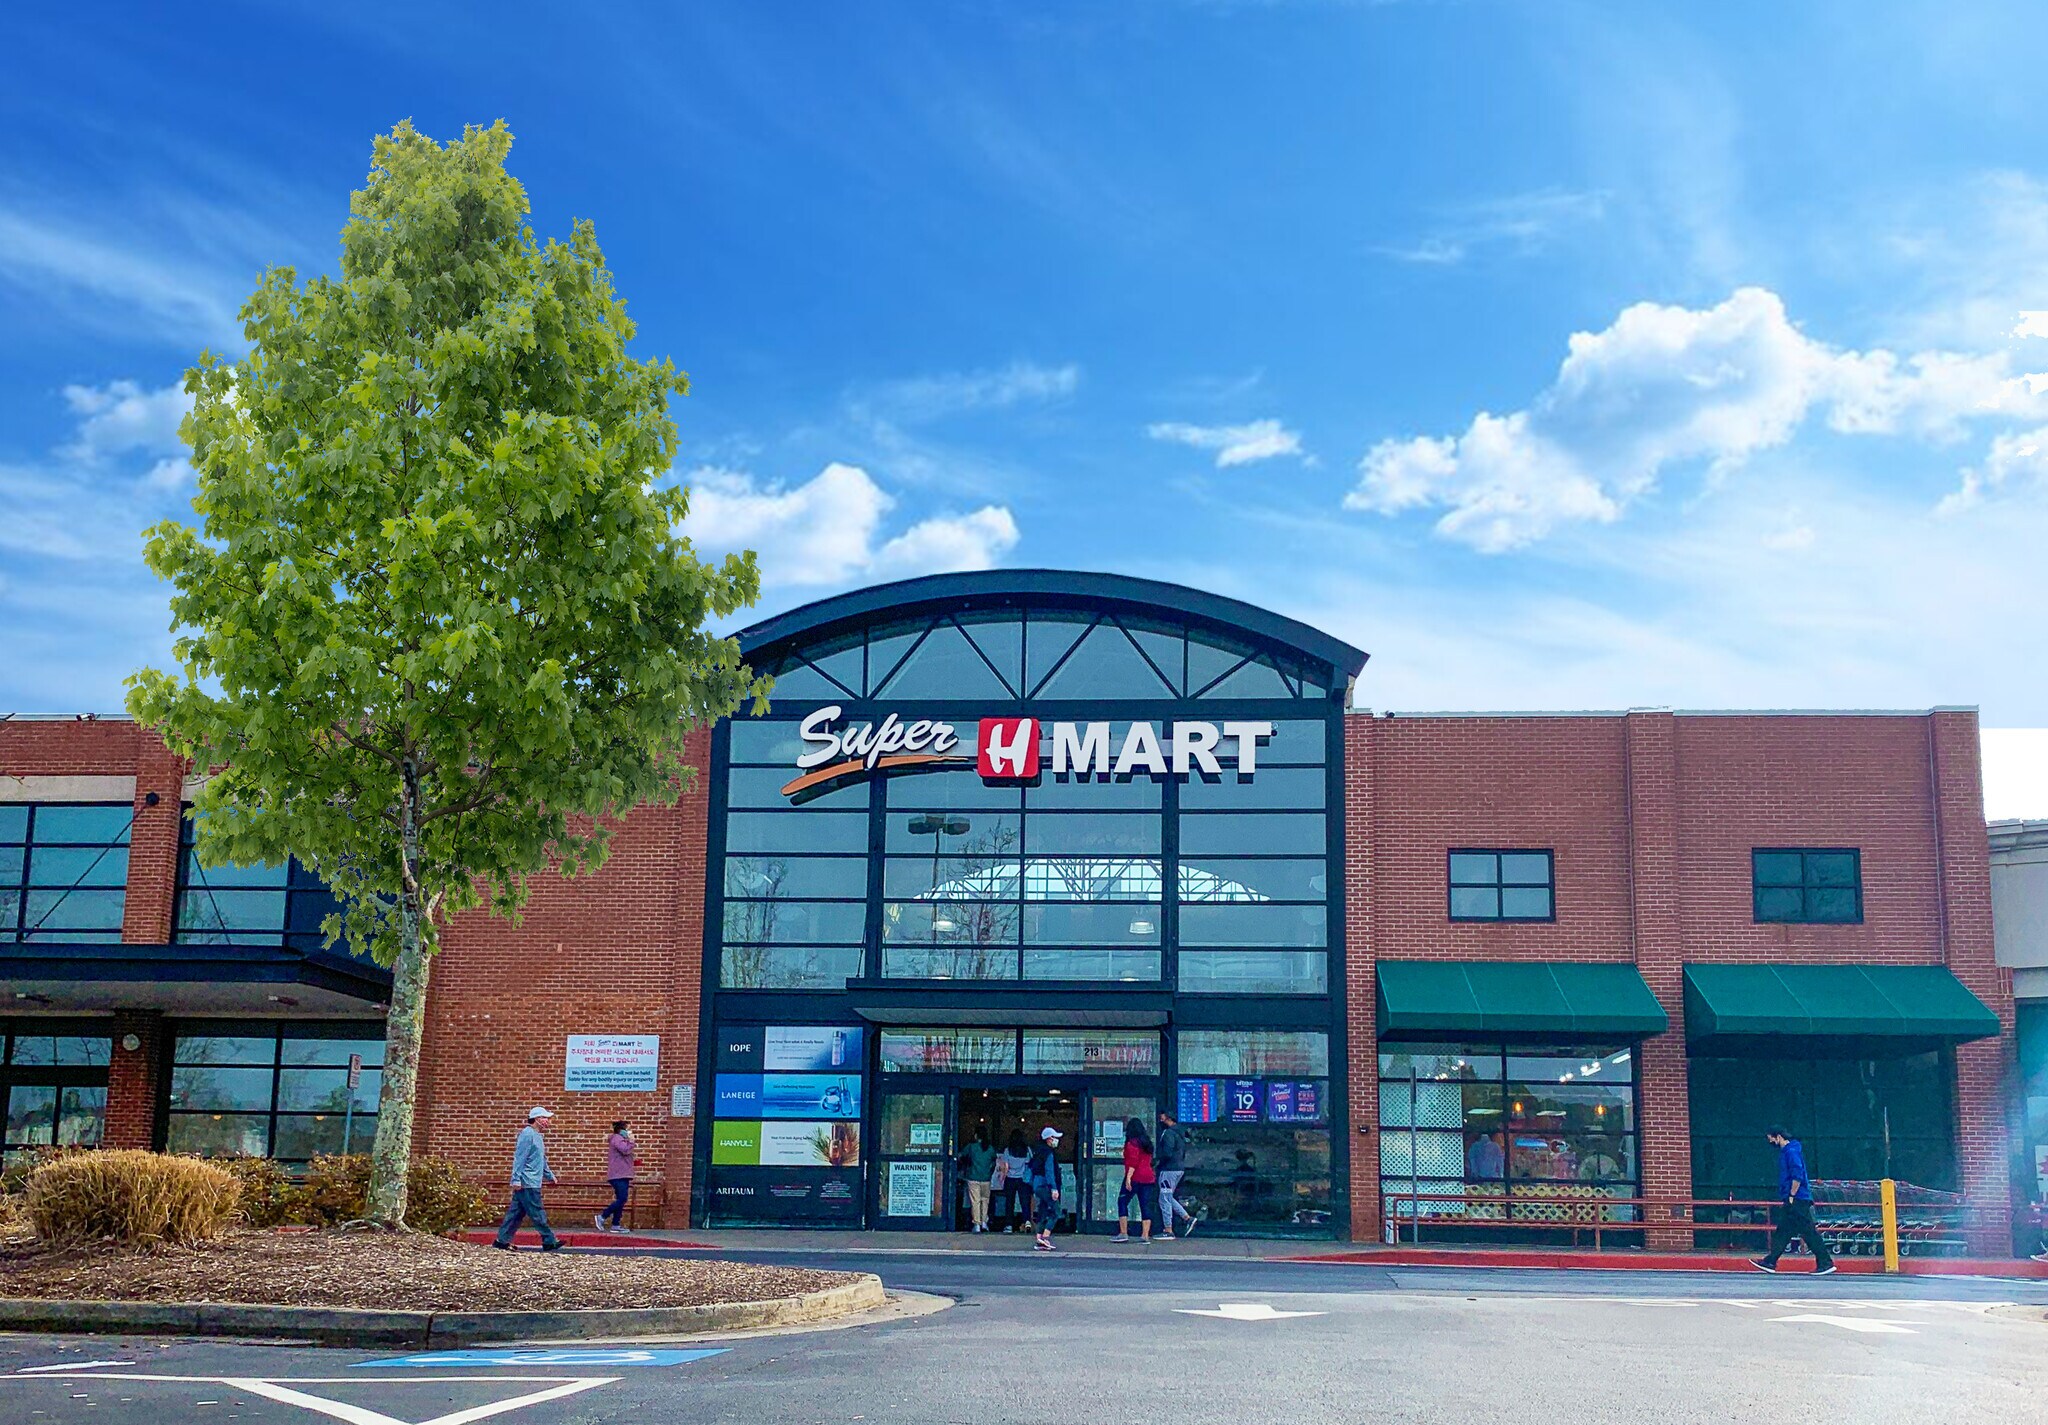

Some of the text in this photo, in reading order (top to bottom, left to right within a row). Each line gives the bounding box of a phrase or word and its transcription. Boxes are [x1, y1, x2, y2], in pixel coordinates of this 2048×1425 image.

[797, 705, 1273, 777] Super H MART
[730, 1044, 751, 1052] IOPE
[1084, 1047, 1099, 1056] 213
[721, 1091, 756, 1099] LANEIGE
[715, 1187, 754, 1195] ARITAUM
